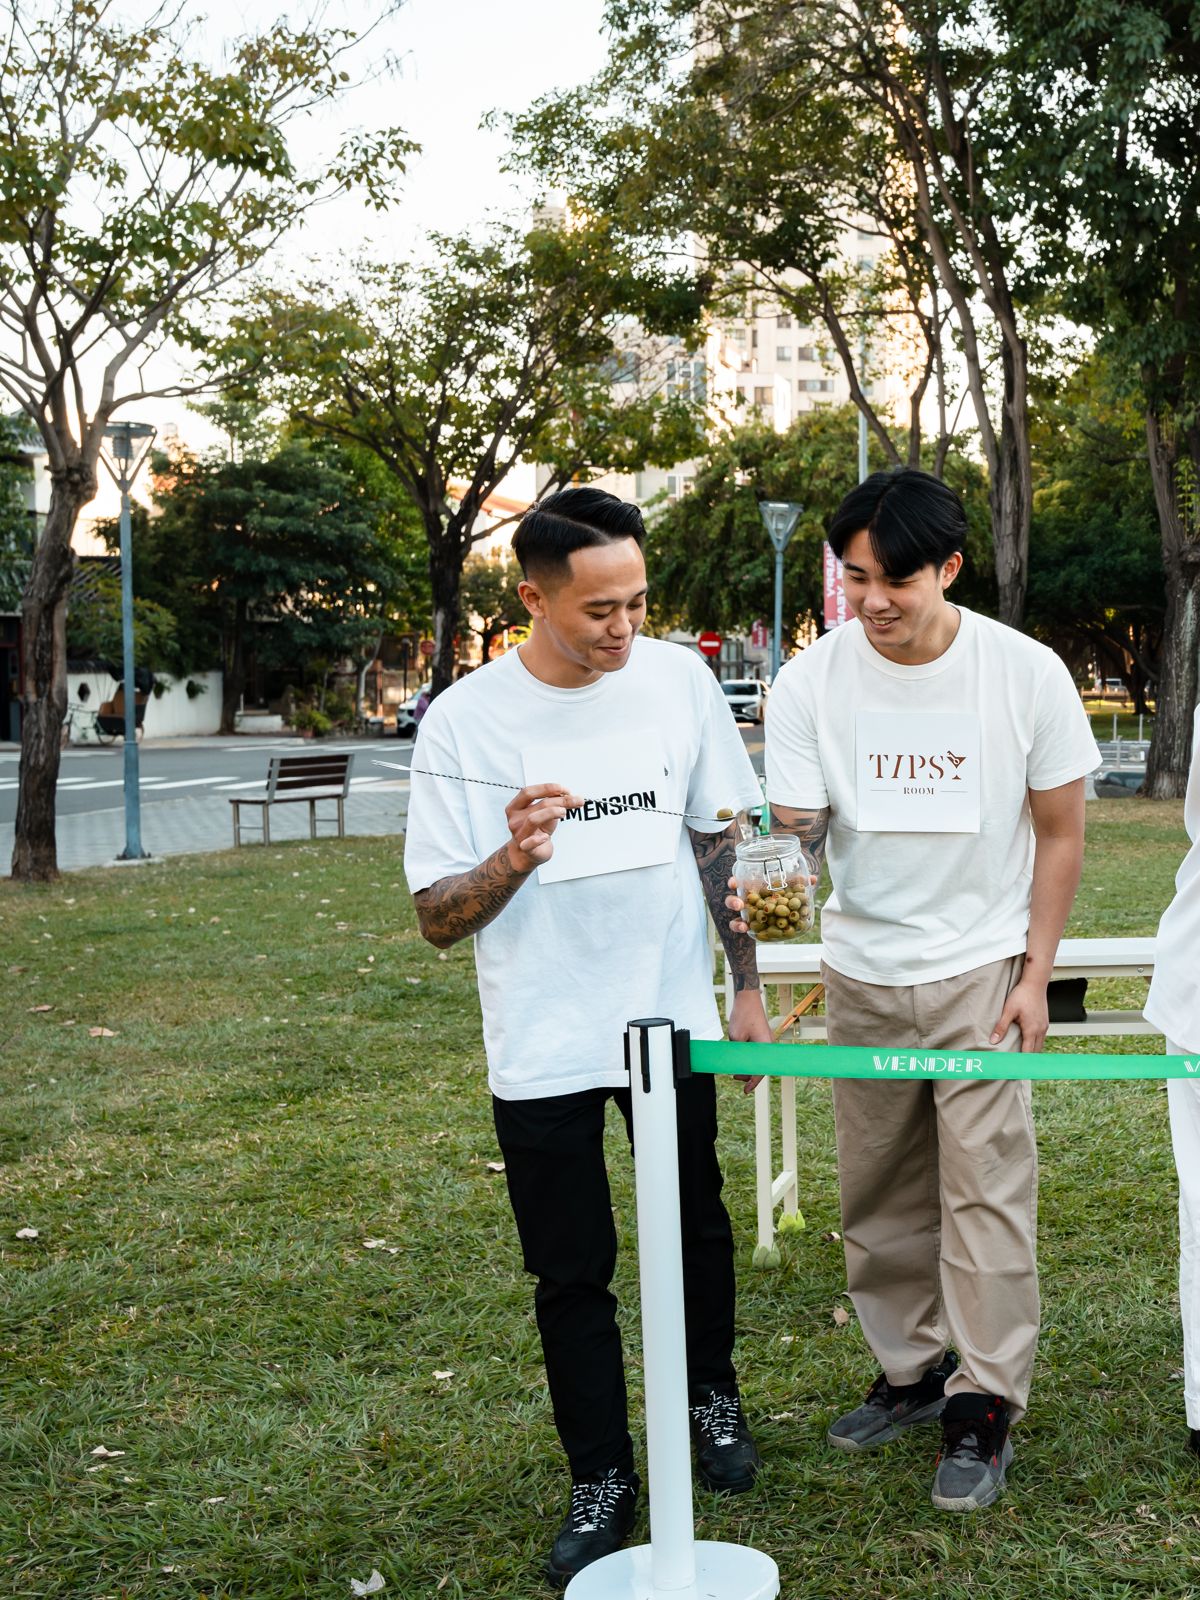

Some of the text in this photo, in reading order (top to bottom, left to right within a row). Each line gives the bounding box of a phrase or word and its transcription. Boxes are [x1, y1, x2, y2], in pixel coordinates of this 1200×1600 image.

[903, 787, 935, 795] ROOM
[560, 790, 656, 822] MENSION
[872, 1055, 984, 1073] VENDER
